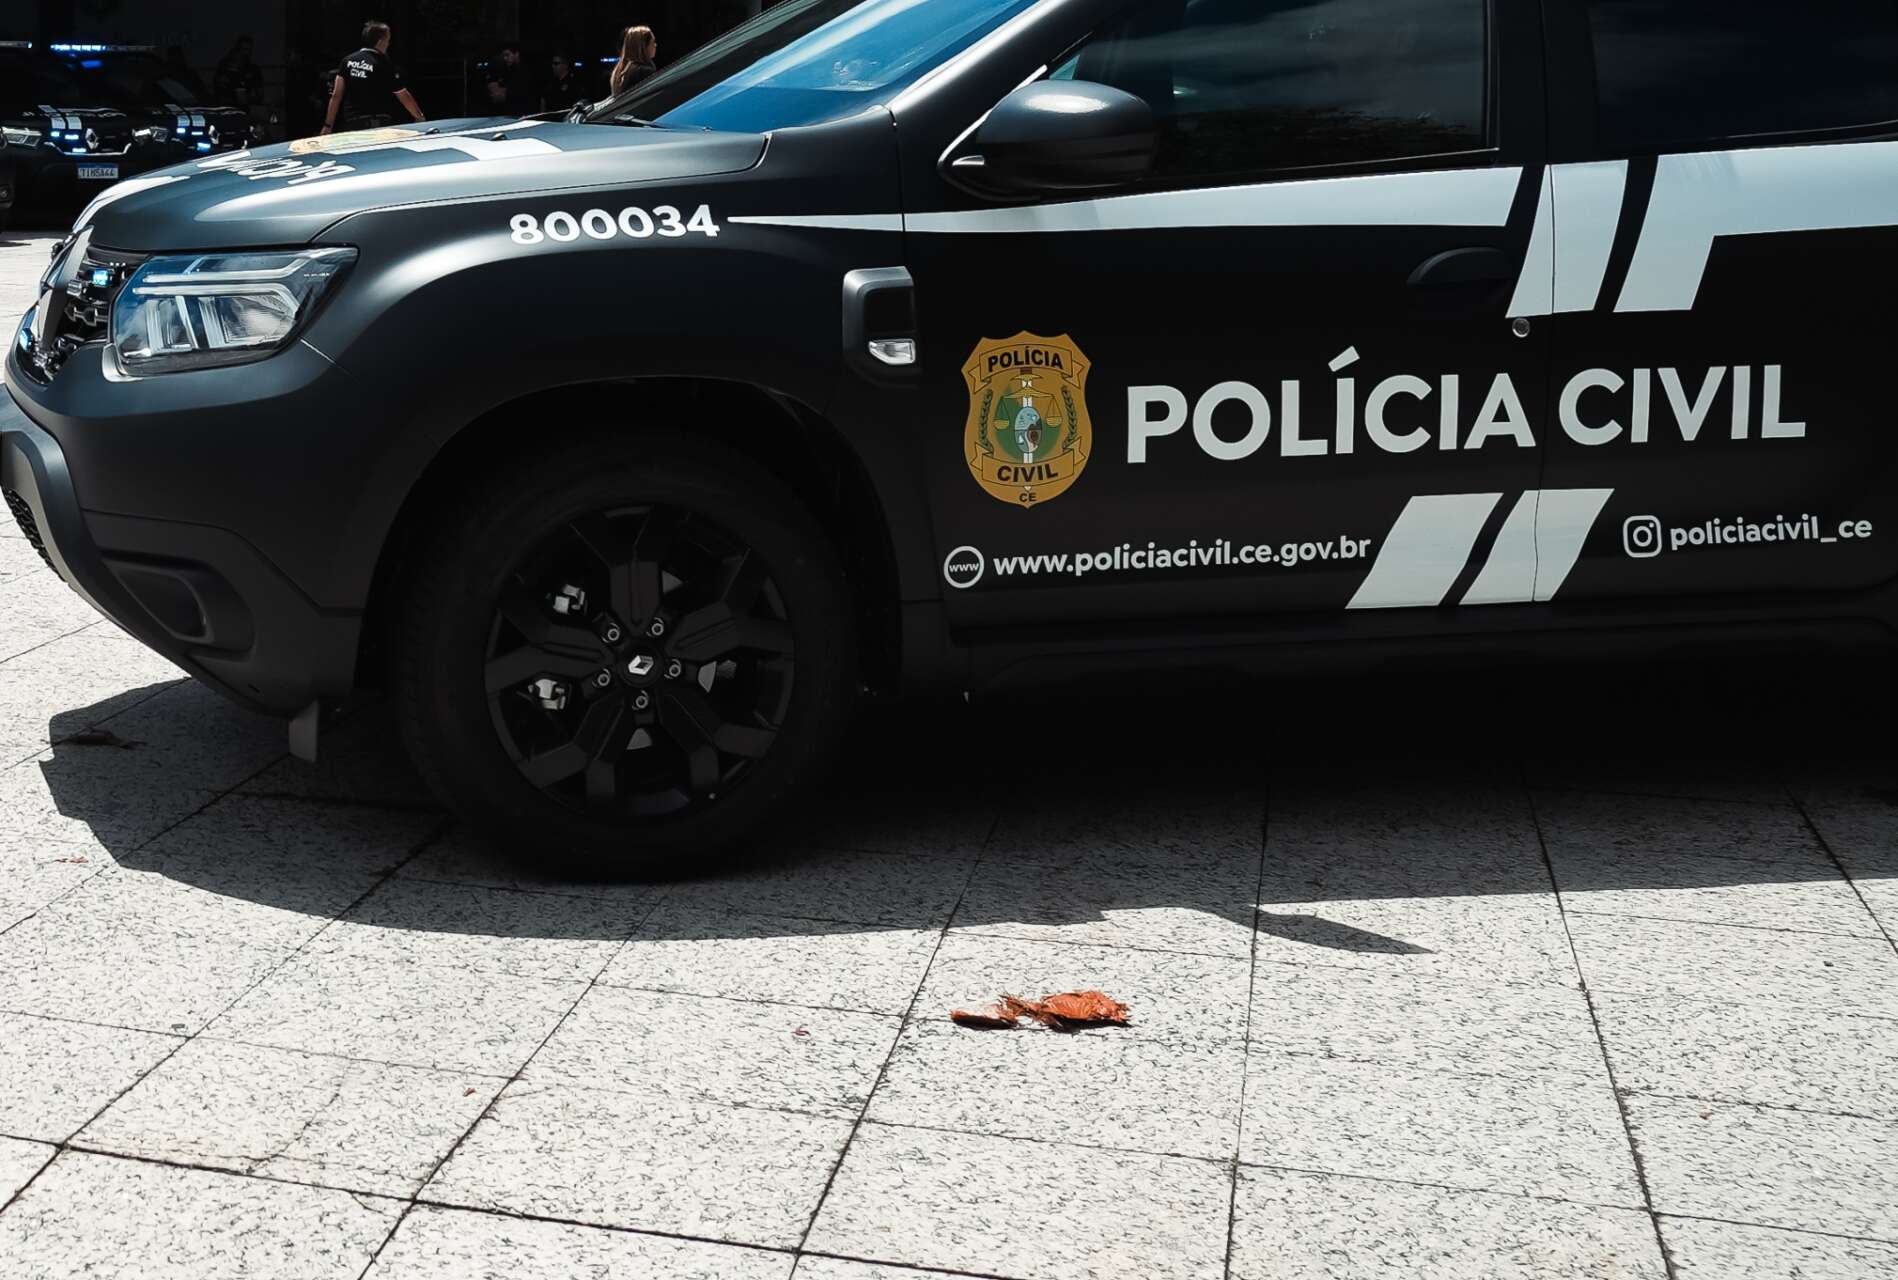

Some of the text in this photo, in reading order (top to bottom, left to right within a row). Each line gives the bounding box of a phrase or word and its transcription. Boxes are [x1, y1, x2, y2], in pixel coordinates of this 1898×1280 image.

[347, 60, 374, 72] POLÍCIA
[350, 69, 368, 78] CIVIL
[509, 204, 720, 245] 800034
[988, 346, 1063, 372] POLÍCIA
[1127, 345, 1806, 463] POLÍCIA CIVIL
[997, 464, 1058, 482] CIVIL
[1019, 493, 1037, 502] CE
[1670, 513, 1873, 551] policiacivil_ce
[993, 535, 1371, 576] www.policiacivil.ce.gov.br
